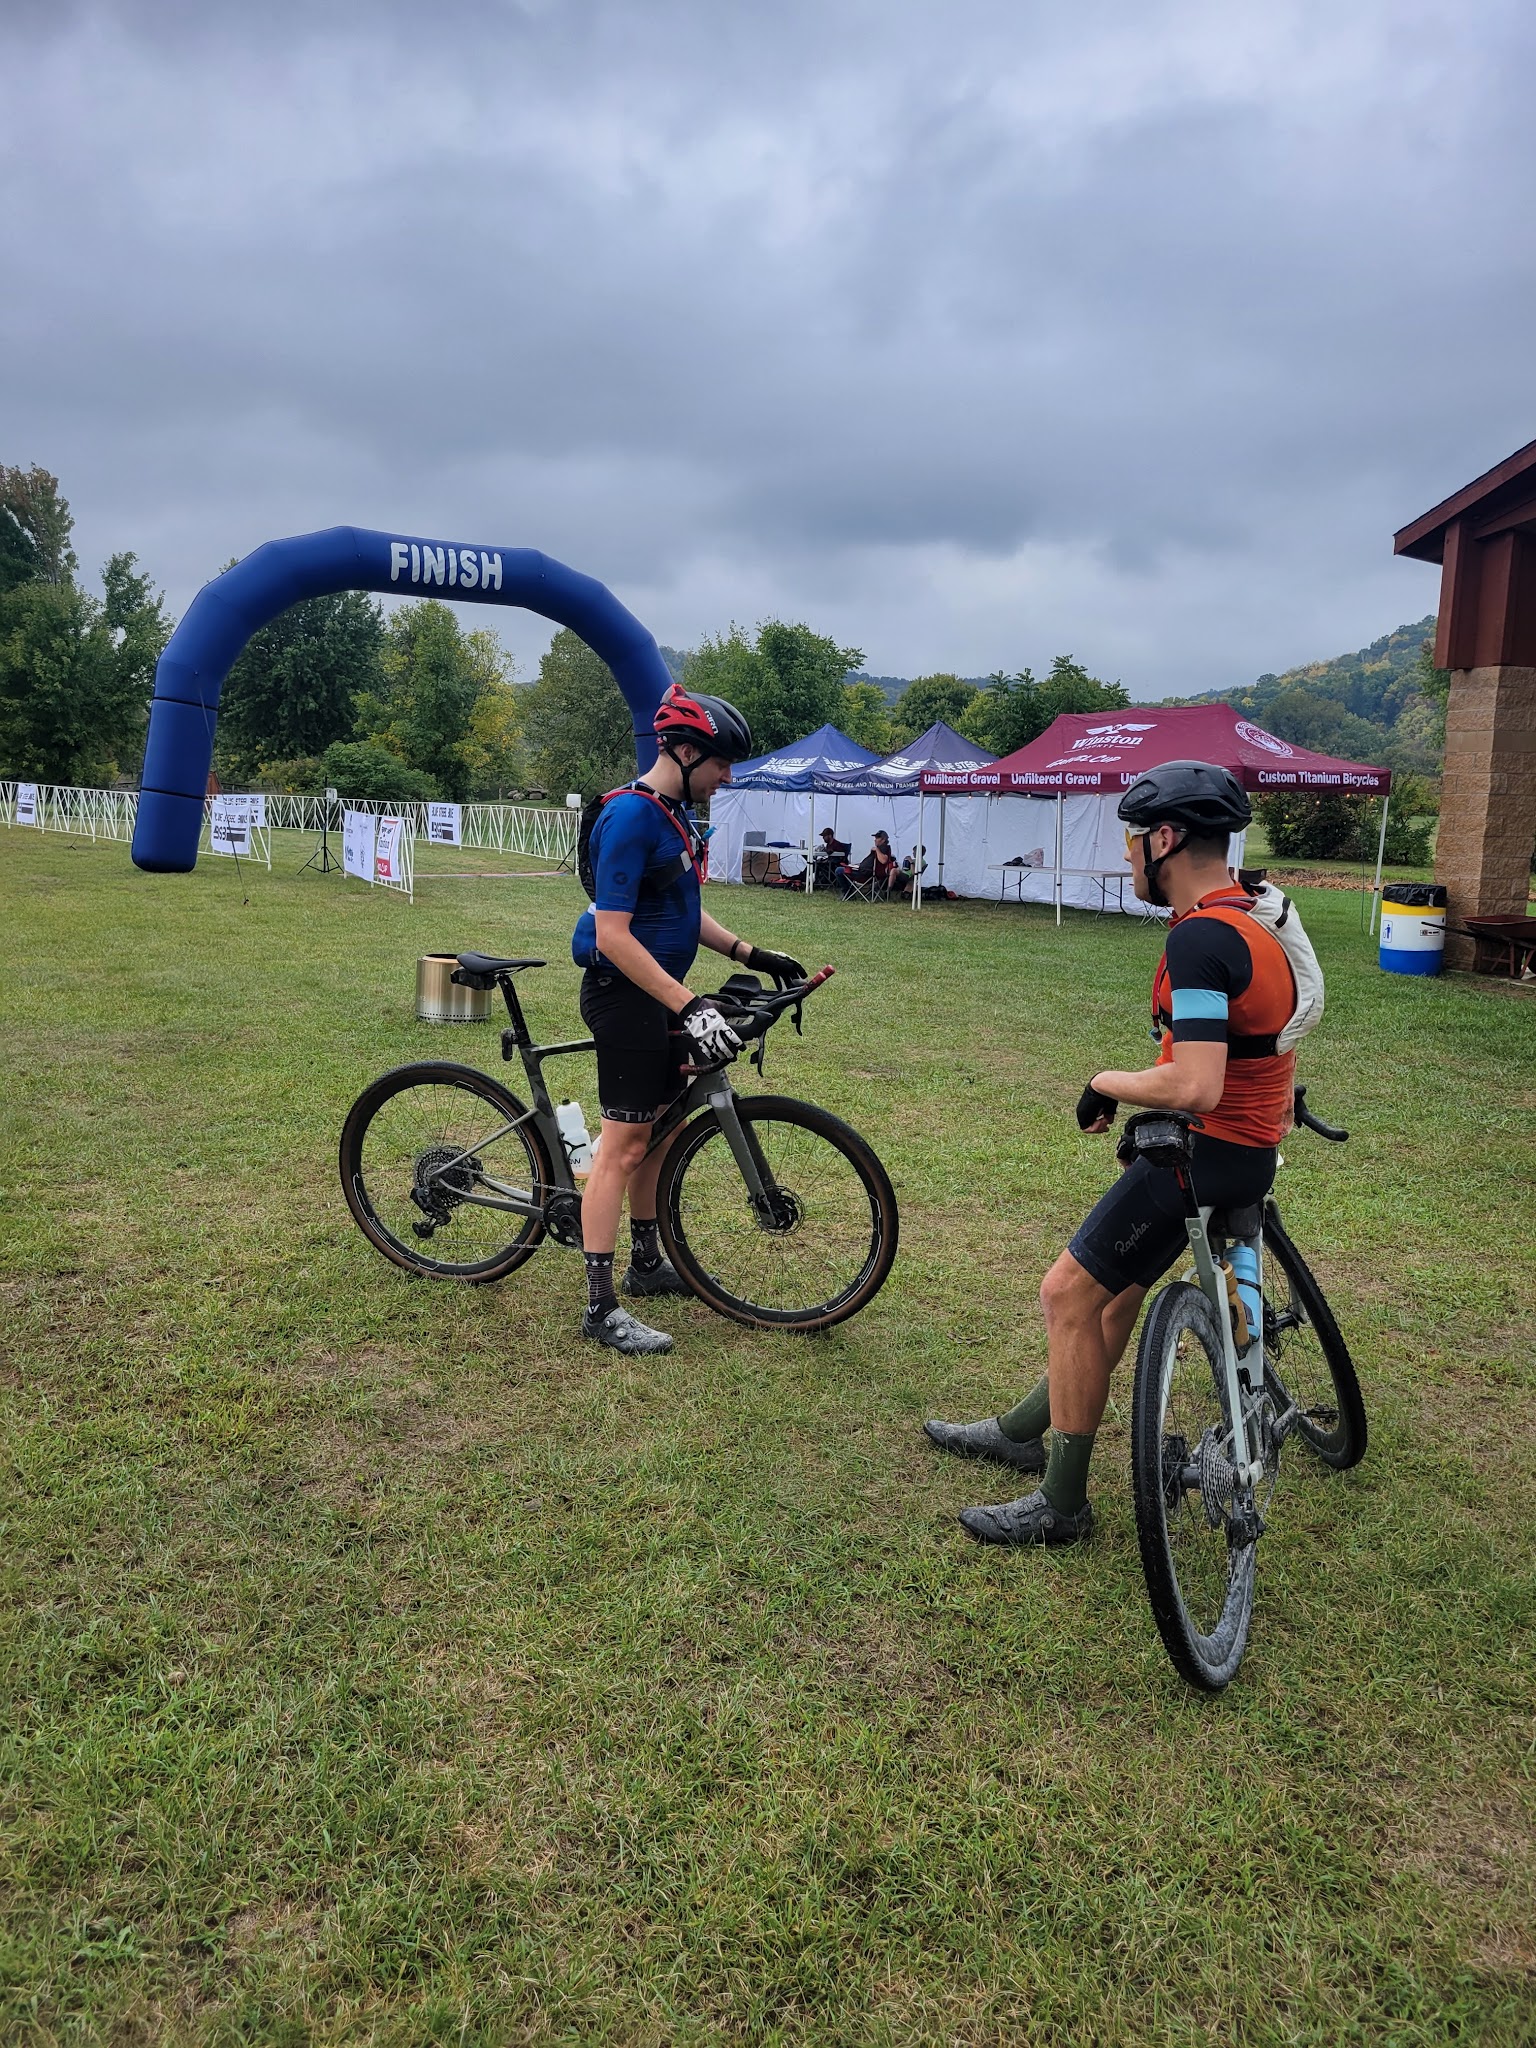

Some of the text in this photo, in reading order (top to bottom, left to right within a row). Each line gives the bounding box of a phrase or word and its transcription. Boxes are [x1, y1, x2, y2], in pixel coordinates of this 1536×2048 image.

[391, 542, 503, 590] FINISH
[705, 710, 719, 735] GIRO
[1072, 734, 1144, 749] Winston
[868, 781, 893, 789] TITANIUM
[895, 781, 919, 789] FRAMES
[924, 773, 1000, 785] Unfiltered Gravel
[1011, 773, 1101, 785] Unfiltered Gravel
[1258, 770, 1379, 787] Custom Titanium Bicycles
